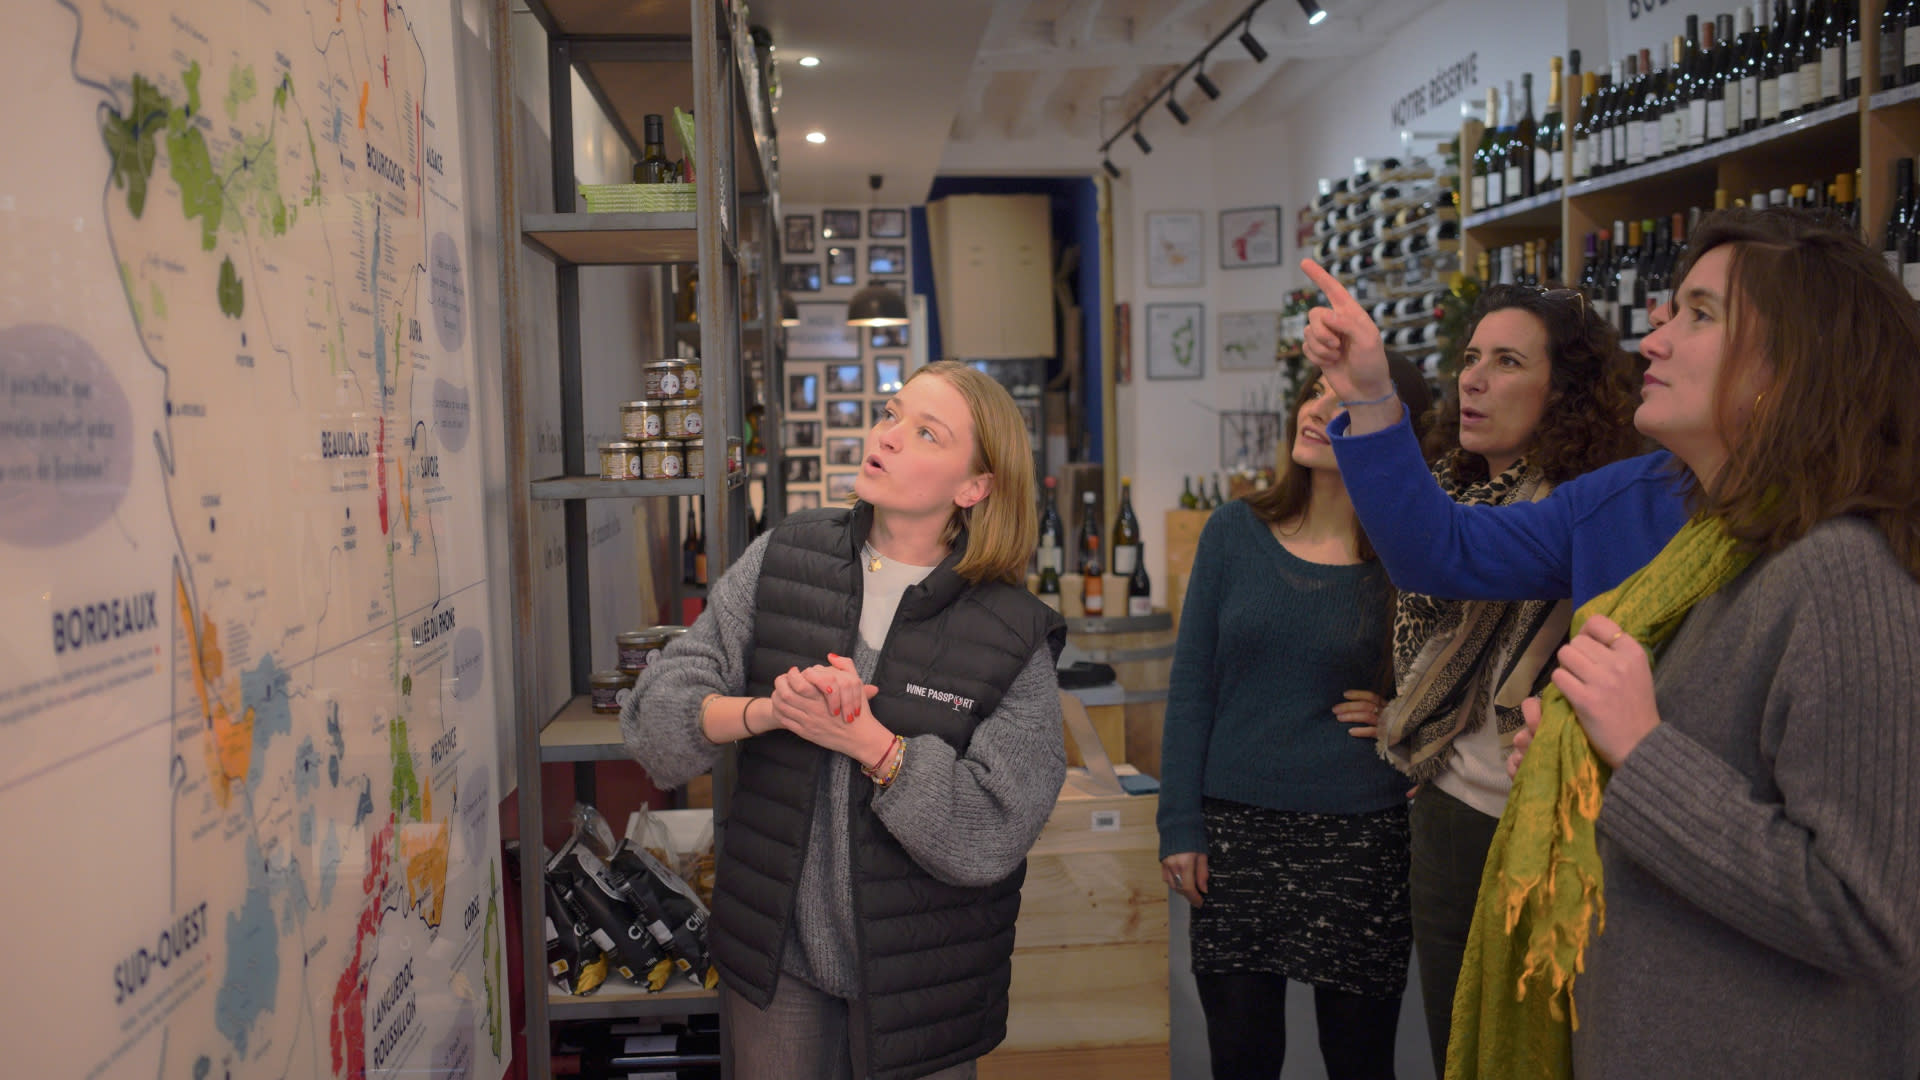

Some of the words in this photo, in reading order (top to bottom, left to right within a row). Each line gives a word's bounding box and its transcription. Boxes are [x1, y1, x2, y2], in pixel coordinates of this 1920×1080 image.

[1391, 85, 1426, 128] NOTRE
[366, 142, 406, 191] BOURGOGNE
[426, 146, 444, 176] ALSACE
[408, 318, 423, 344] JURA
[321, 431, 369, 459] BEAUJOLAIS
[420, 455, 440, 479] SAVOIE
[53, 591, 158, 654] BORDEAUX
[411, 616, 430, 648] VALLÉE
[430, 616, 438, 640] DU
[906, 682, 927, 697] WINE
[927, 688, 975, 711] PASSPORT
[430, 726, 457, 768] PROVENCE
[463, 894, 480, 931] CORSE
[114, 901, 207, 1005] SUD-OUEST
[372, 956, 414, 1032] LANGUEDOC
[373, 992, 416, 1071] ROUSSILLON
